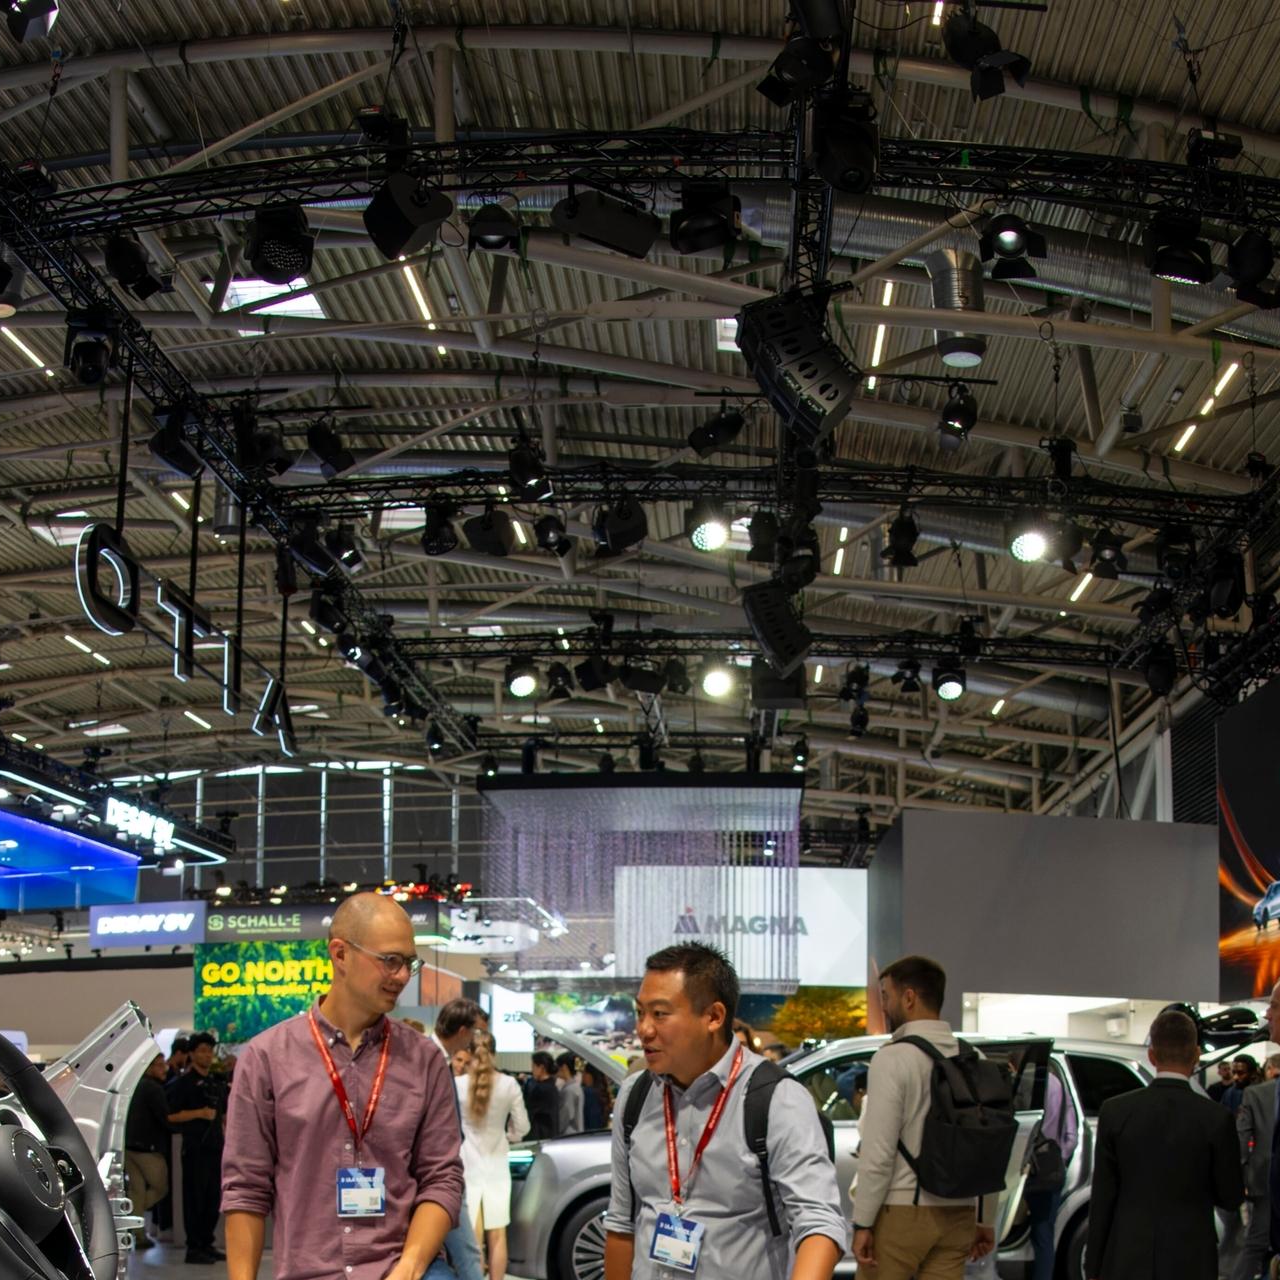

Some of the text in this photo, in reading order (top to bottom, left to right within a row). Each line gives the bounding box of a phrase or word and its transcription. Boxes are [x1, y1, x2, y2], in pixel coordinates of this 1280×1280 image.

[227, 913, 301, 929] SCHALL-E
[703, 915, 809, 936] MAGNA
[201, 959, 333, 983] GO NORTH
